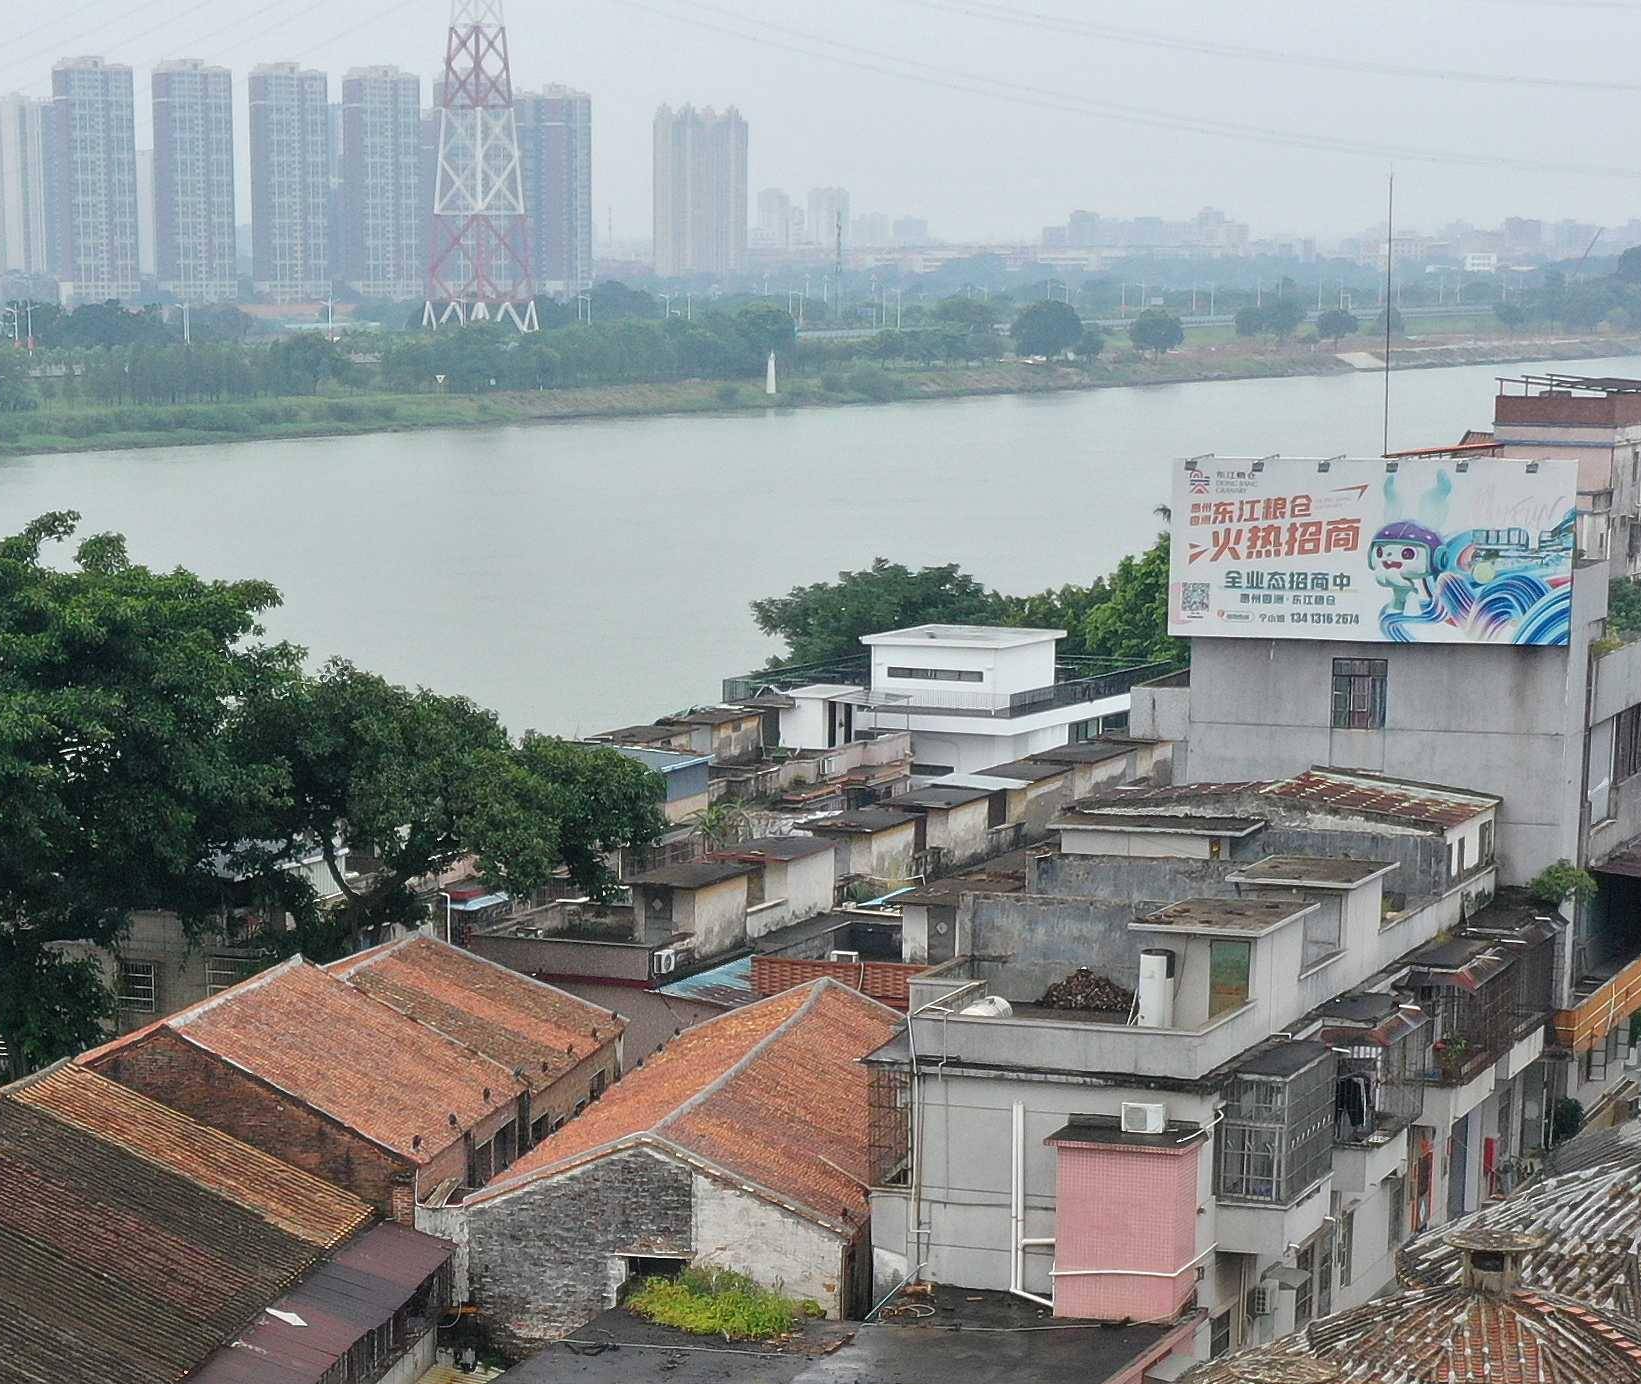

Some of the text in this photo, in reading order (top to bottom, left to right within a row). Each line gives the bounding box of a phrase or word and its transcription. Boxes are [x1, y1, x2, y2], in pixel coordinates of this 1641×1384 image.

[1212, 494, 1312, 525] 东江粮仓
[1210, 517, 1362, 562] 火热招商
[1224, 570, 1352, 591] 全业态招商中
